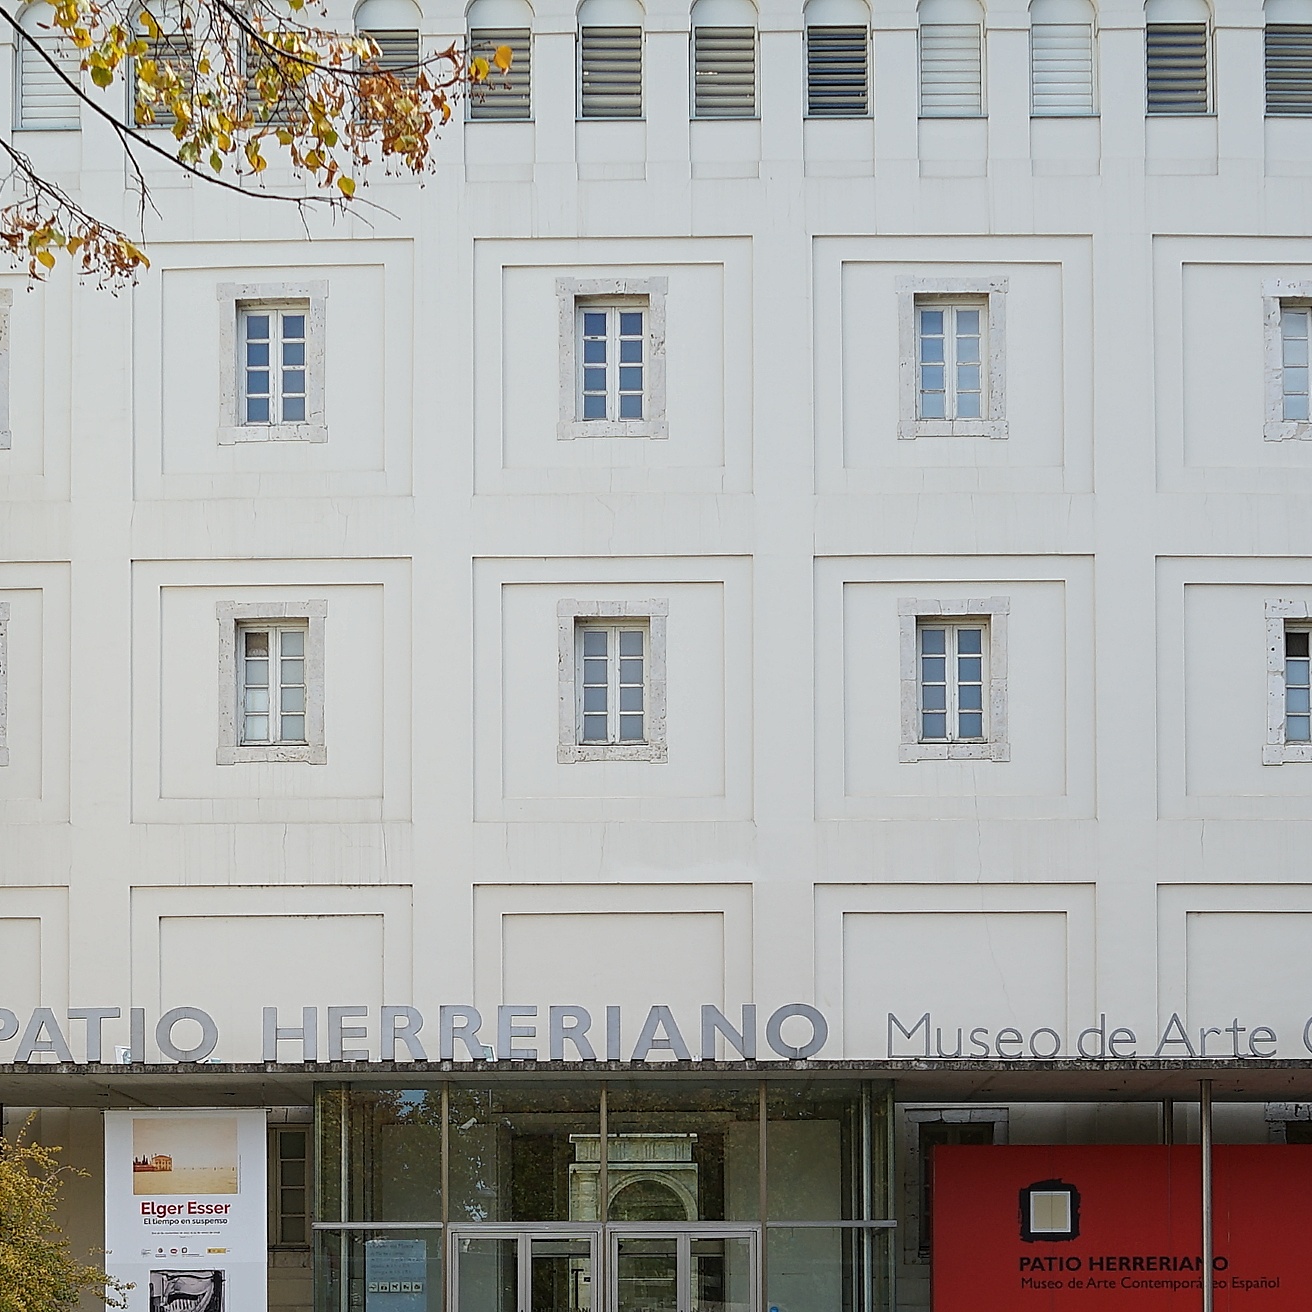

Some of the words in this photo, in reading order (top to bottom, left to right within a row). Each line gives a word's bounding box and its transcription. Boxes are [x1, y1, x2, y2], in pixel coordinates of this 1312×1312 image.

[262, 1003, 829, 1062] HERRERIANO
[887, 1011, 1062, 1058] Museo
[1077, 1012, 1137, 1058] de
[1155, 1011, 1278, 1058] Arte
[141, 1201, 184, 1218] Elger
[187, 1201, 231, 1215] Esser
[152, 1218, 180, 1226] tiempo
[192, 1218, 228, 1226] suspenso
[1019, 1256, 1082, 1271] PATIO
[1021, 1277, 1064, 1289] Museo
[1067, 1277, 1084, 1289] de
[1085, 1277, 1116, 1289] Arte
[1120, 1276, 1227, 1292] Contemporáeo
[1232, 1276, 1280, 1292] Español
